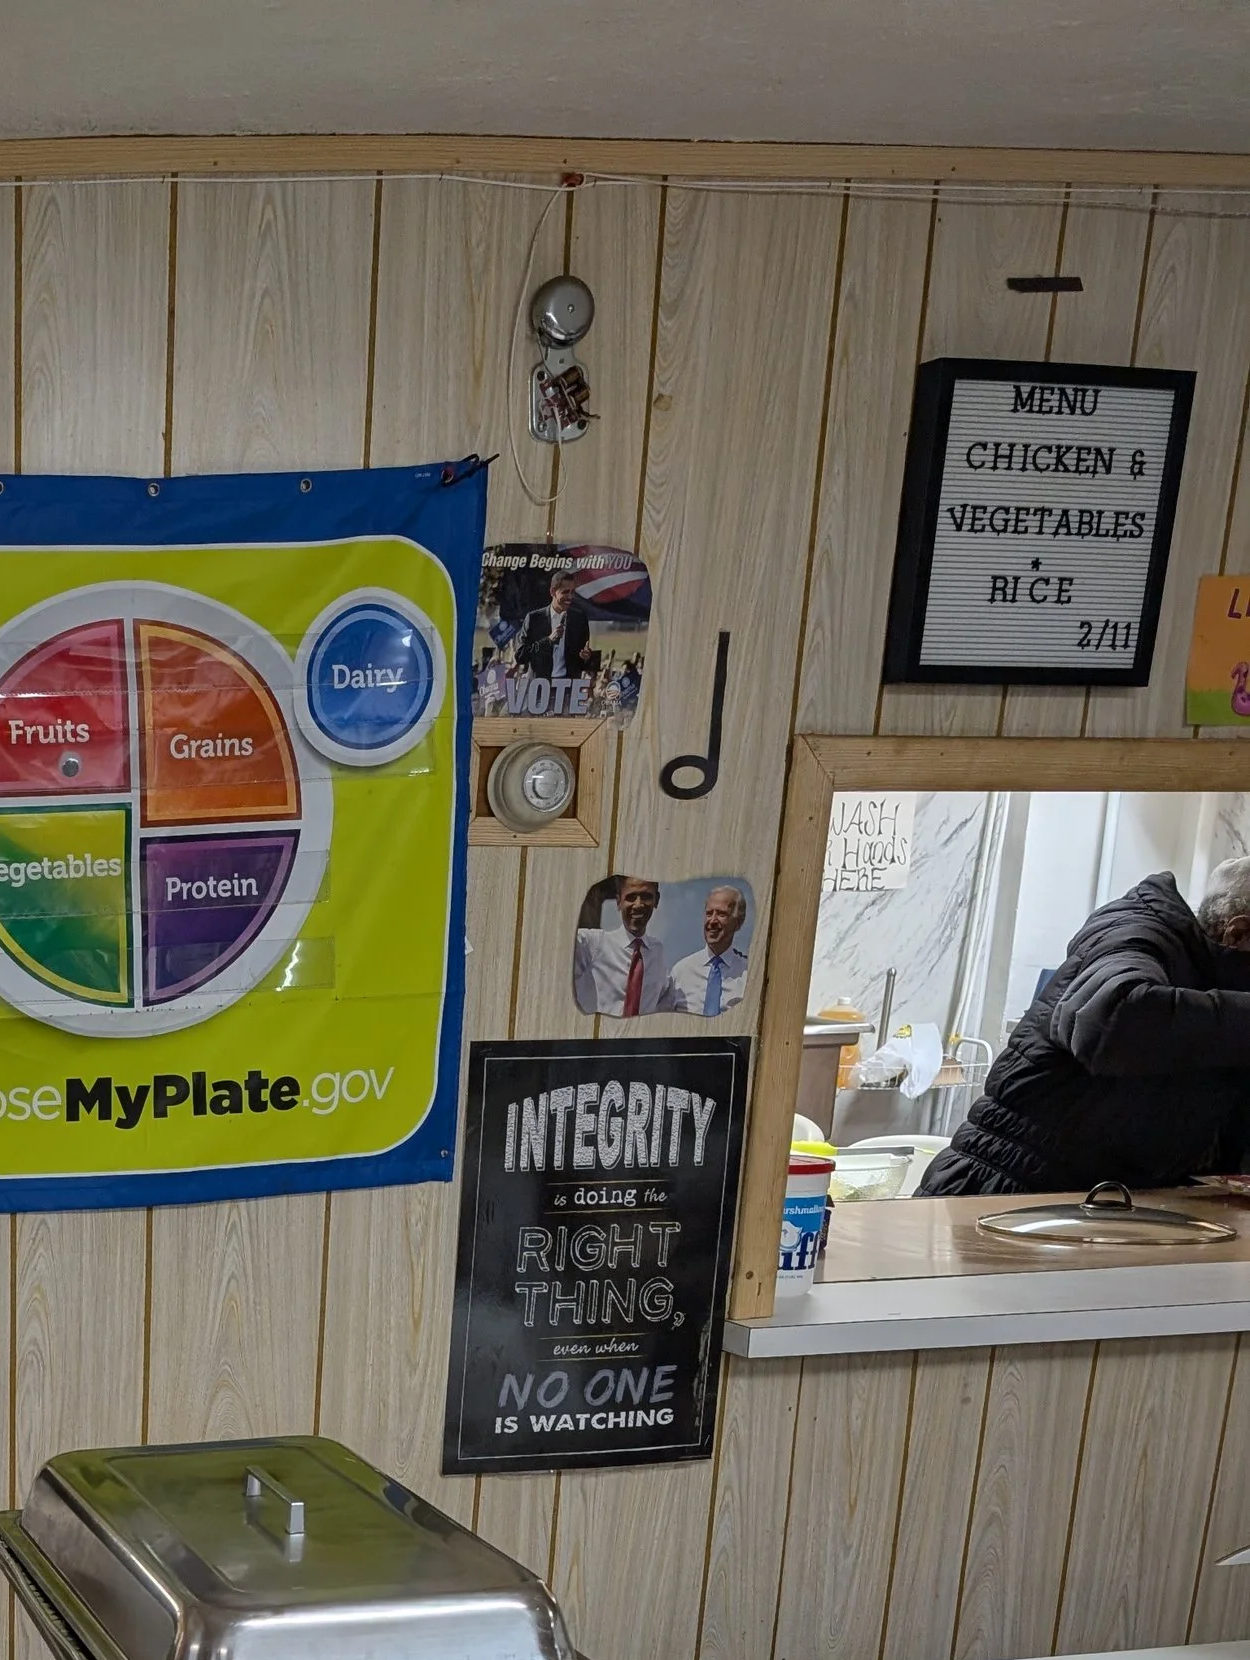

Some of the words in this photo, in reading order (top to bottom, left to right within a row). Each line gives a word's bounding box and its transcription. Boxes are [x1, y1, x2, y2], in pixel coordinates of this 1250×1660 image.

[1010, 385, 1102, 416] MENU
[966, 442, 1117, 477] CHICKEN
[1130, 449, 1147, 480] &
[947, 504, 1147, 541] VEGETABLES
[482, 552, 527, 571] Change
[530, 553, 573, 571] Begins
[576, 554, 605, 570] with
[606, 554, 633, 570] YOU
[988, 575, 1075, 605] RICE
[1075, 619, 1133, 650] 2/11
[332, 662, 404, 694] Dairy
[506, 677, 591, 716] VOTE
[9, 718, 90, 745] Fruits
[169, 733, 254, 759] Grains
[842, 836, 908, 869] Hands
[165, 872, 259, 901] Protein
[504, 1079, 717, 1172] INTEGRITY
[553, 1193, 567, 1206] is
[574, 1187, 637, 1207] doing
[644, 1188, 668, 1202] the
[517, 1221, 682, 1272] RIGHT
[515, 1277, 687, 1330] THING,
[553, 1342, 592, 1355] even
[595, 1337, 640, 1354] when
[498, 1370, 570, 1411] NO
[584, 1365, 678, 1406] ONE
[494, 1416, 519, 1434] IS
[530, 1408, 674, 1433] WATCHING
